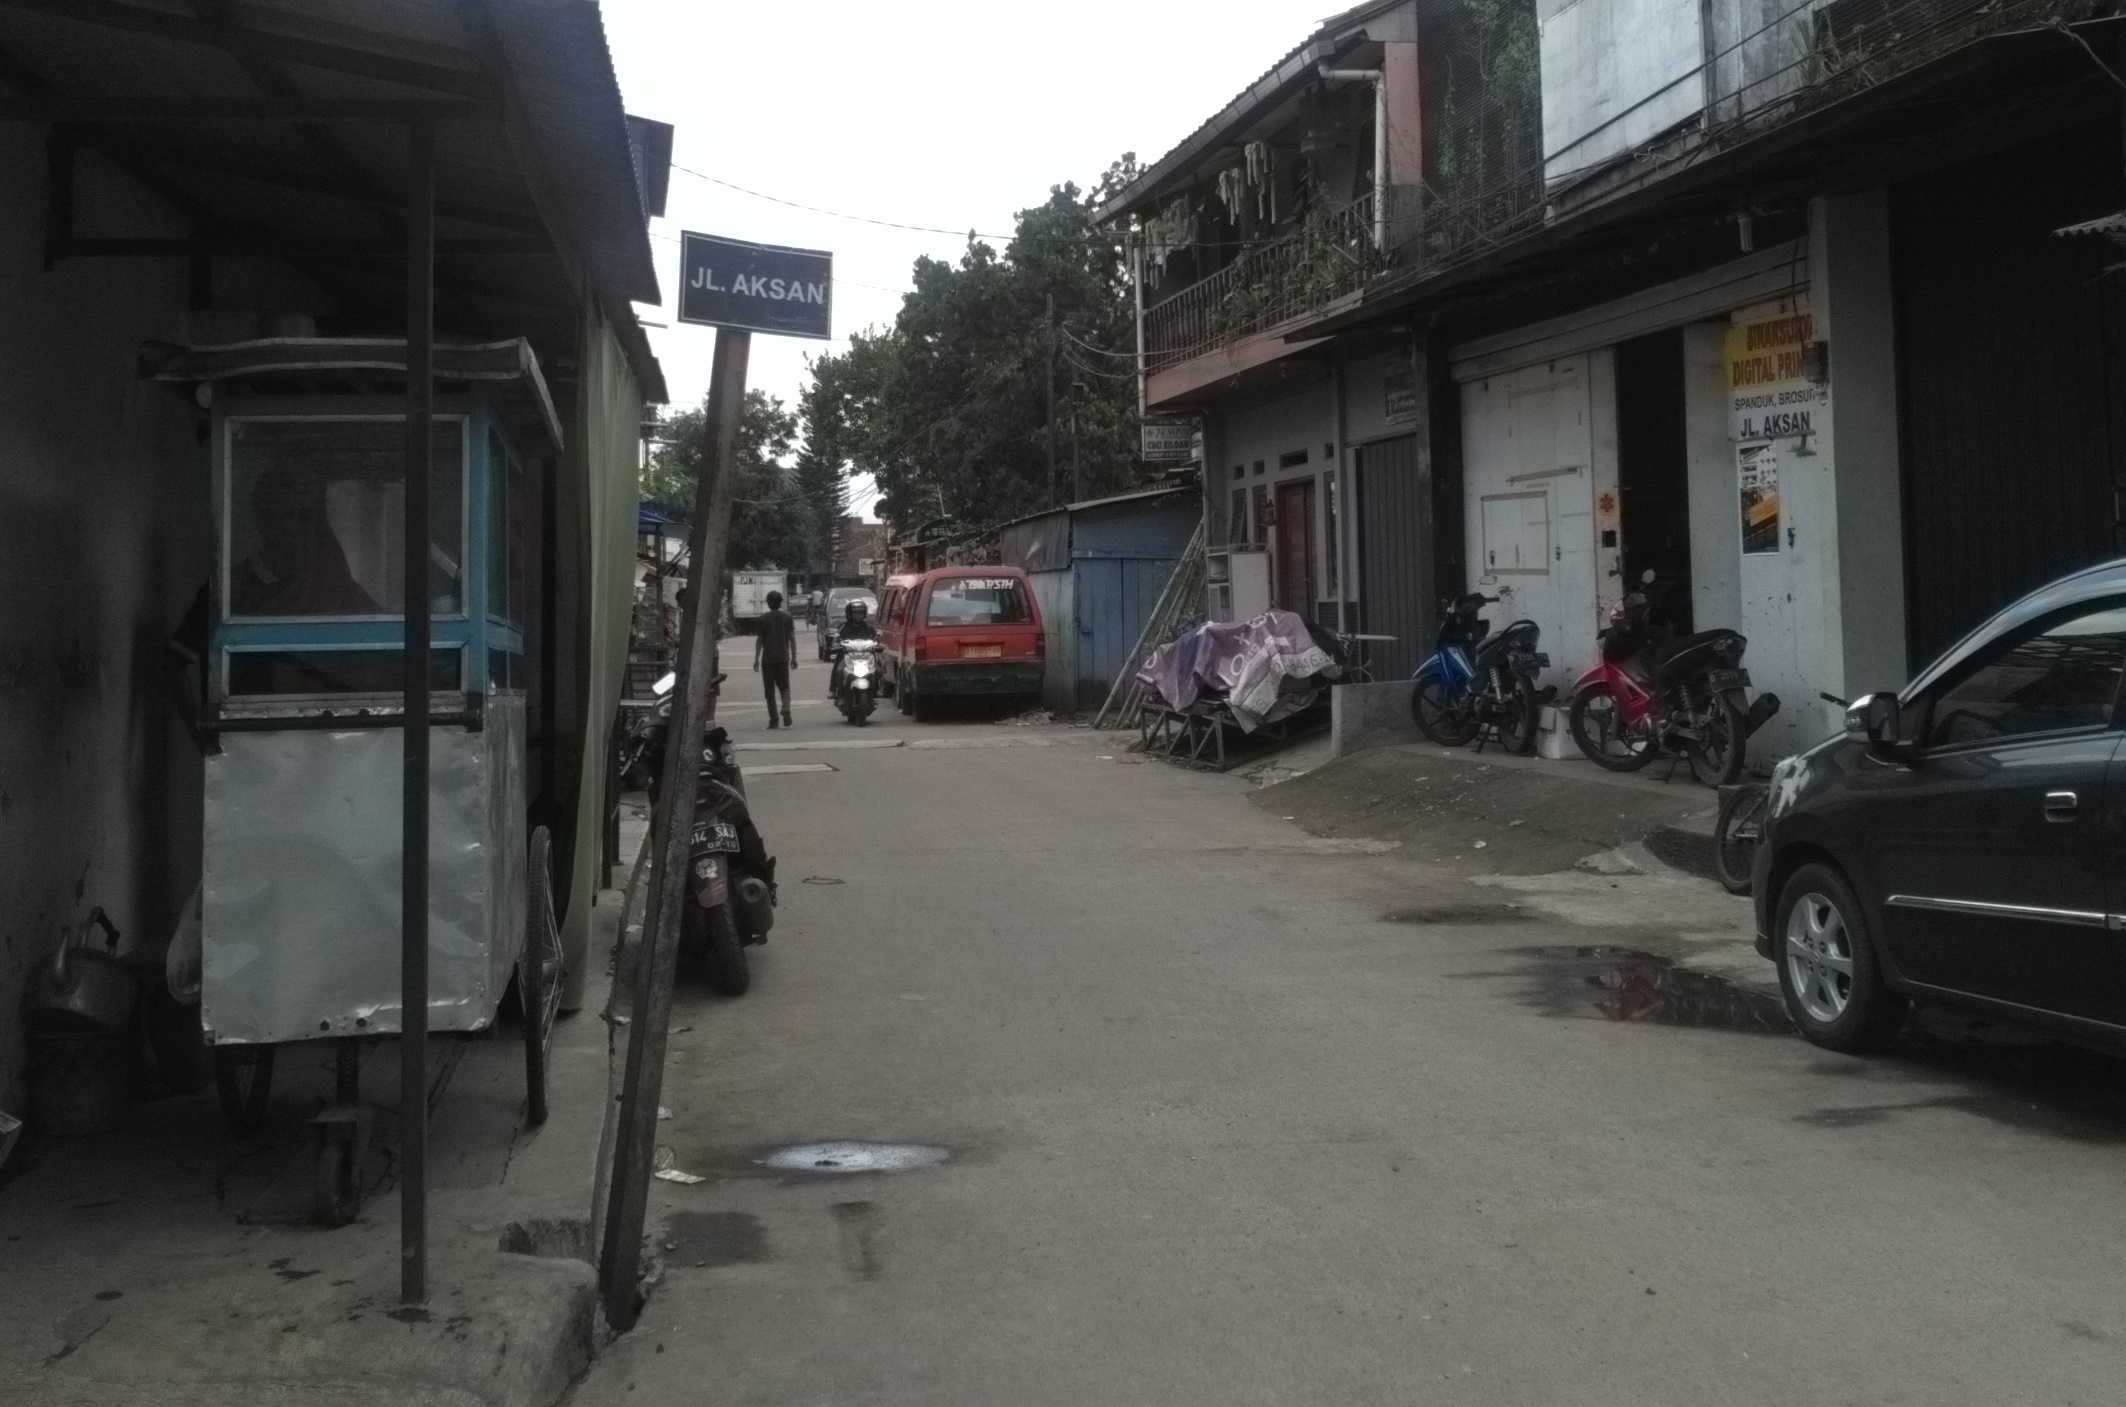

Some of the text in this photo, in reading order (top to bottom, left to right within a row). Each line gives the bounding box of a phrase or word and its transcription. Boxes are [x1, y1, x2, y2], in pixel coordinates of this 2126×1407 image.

[691, 267, 824, 305] JL. AKSAN
[1733, 355, 1775, 387] DIGITAL
[1734, 394, 1777, 411] SPANDUK,
[1740, 411, 1810, 437] JL. AKSAN
[715, 826, 735, 839] SAJ
